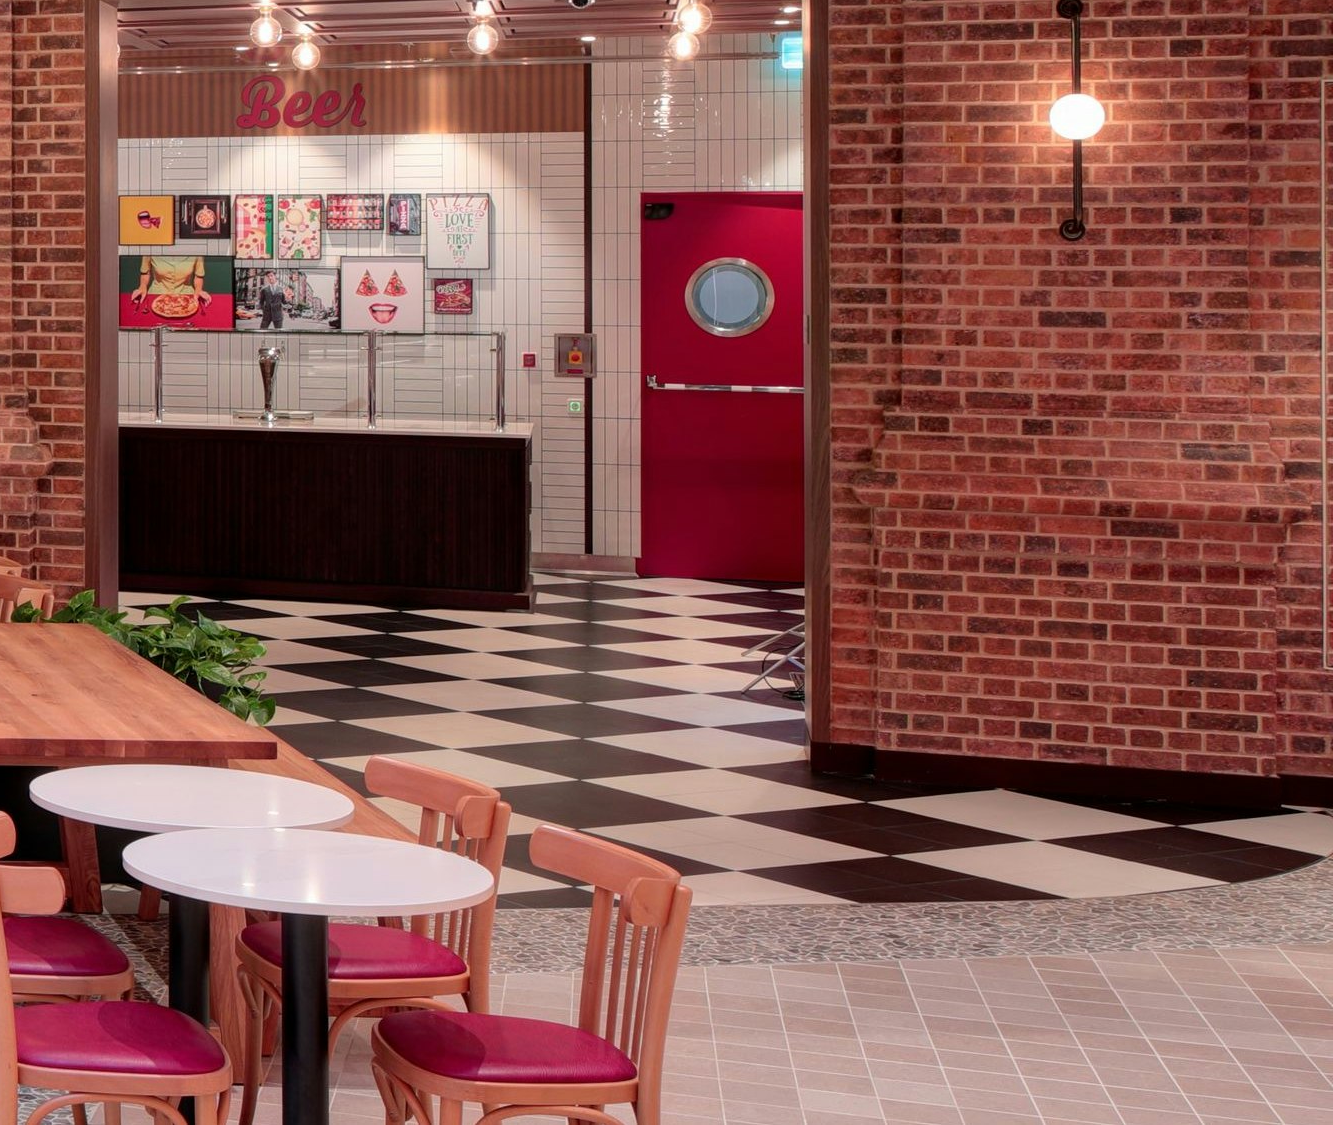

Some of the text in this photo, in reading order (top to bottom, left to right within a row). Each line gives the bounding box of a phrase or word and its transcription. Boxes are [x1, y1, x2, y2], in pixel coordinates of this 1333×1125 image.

[236, 75, 367, 129] Beer
[445, 213, 474, 228] LOVE
[446, 233, 474, 245] FIRST
